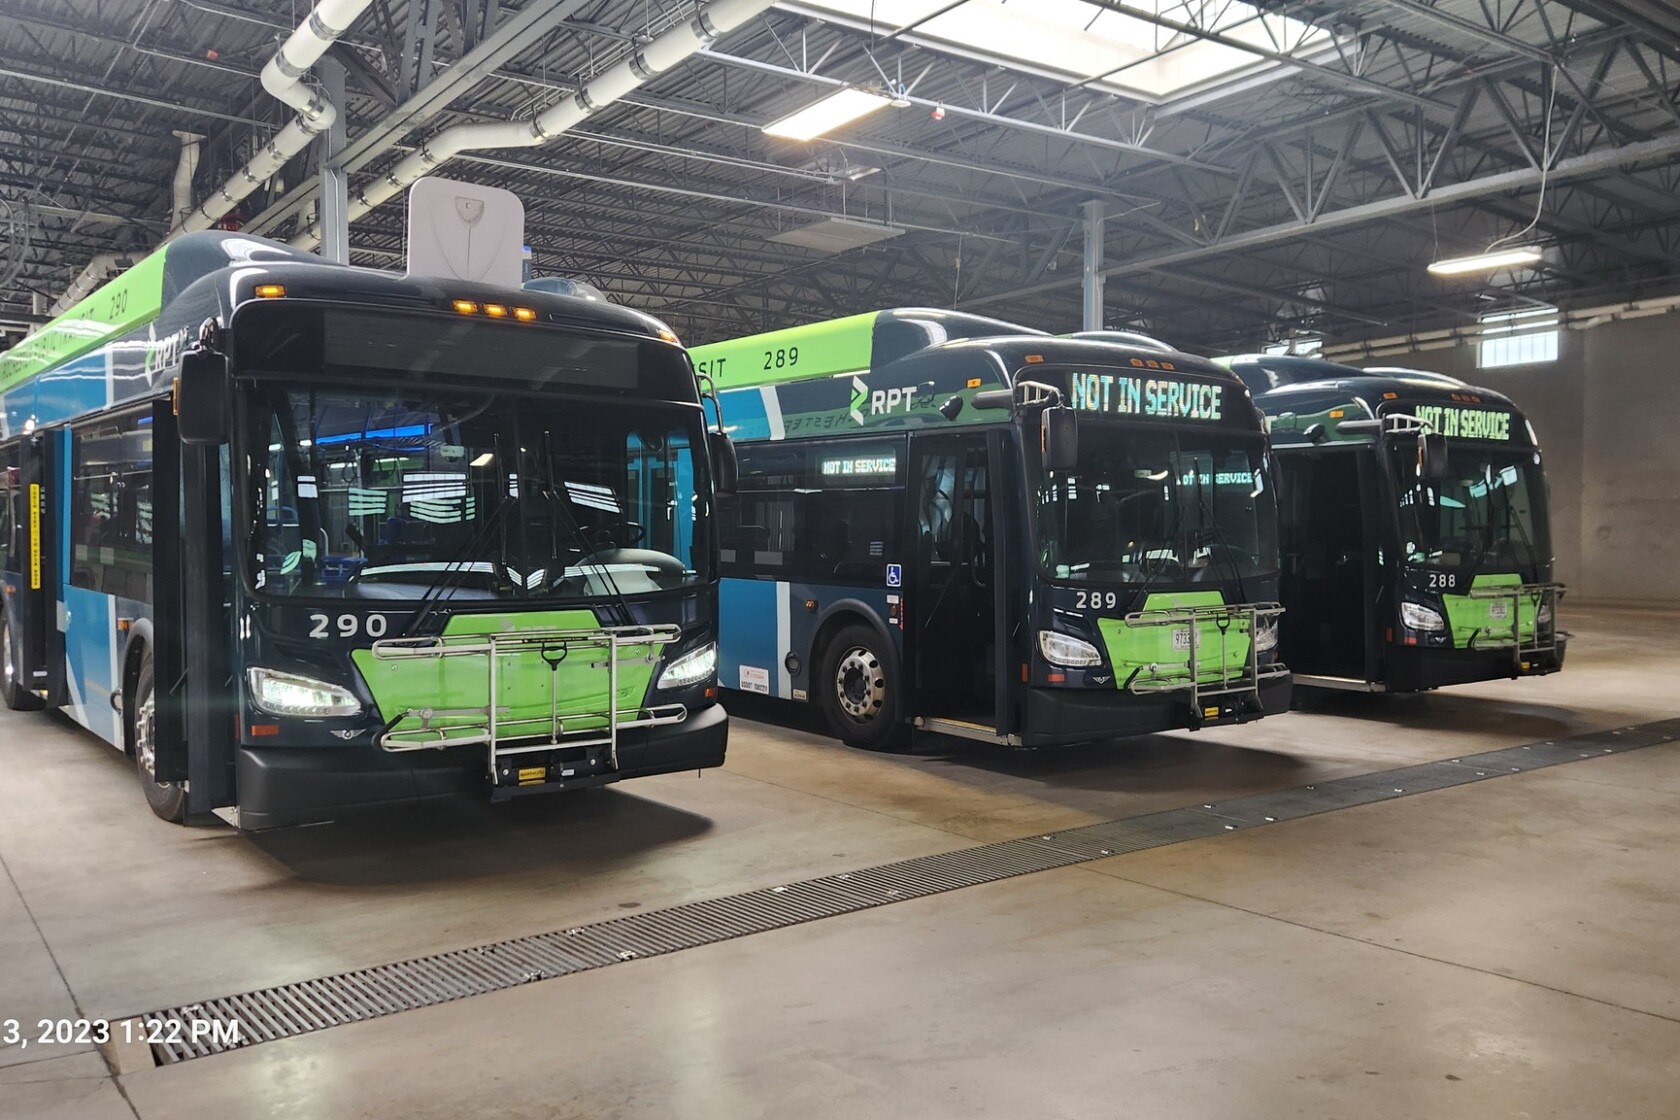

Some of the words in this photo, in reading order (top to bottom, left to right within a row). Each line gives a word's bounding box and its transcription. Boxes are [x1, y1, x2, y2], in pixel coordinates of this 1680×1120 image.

[109, 288, 128, 320] 290
[692, 358, 726, 381] SIT
[763, 346, 799, 371] 289
[871, 386, 918, 416] RPT
[1071, 372, 1114, 412] NOT
[1117, 377, 1142, 415] IN
[1145, 380, 1222, 420] SERVICE
[1415, 404, 1442, 434] NOT
[1443, 407, 1459, 437] IN
[1460, 409, 1511, 440] SERVICE
[822, 460, 841, 475] NOT
[842, 459, 854, 474] IN
[855, 457, 896, 473] SERVICE
[1215, 472, 1253, 485] SERVICE
[1428, 574, 1456, 588] 288
[1075, 591, 1118, 609] 289
[309, 613, 389, 638] 290
